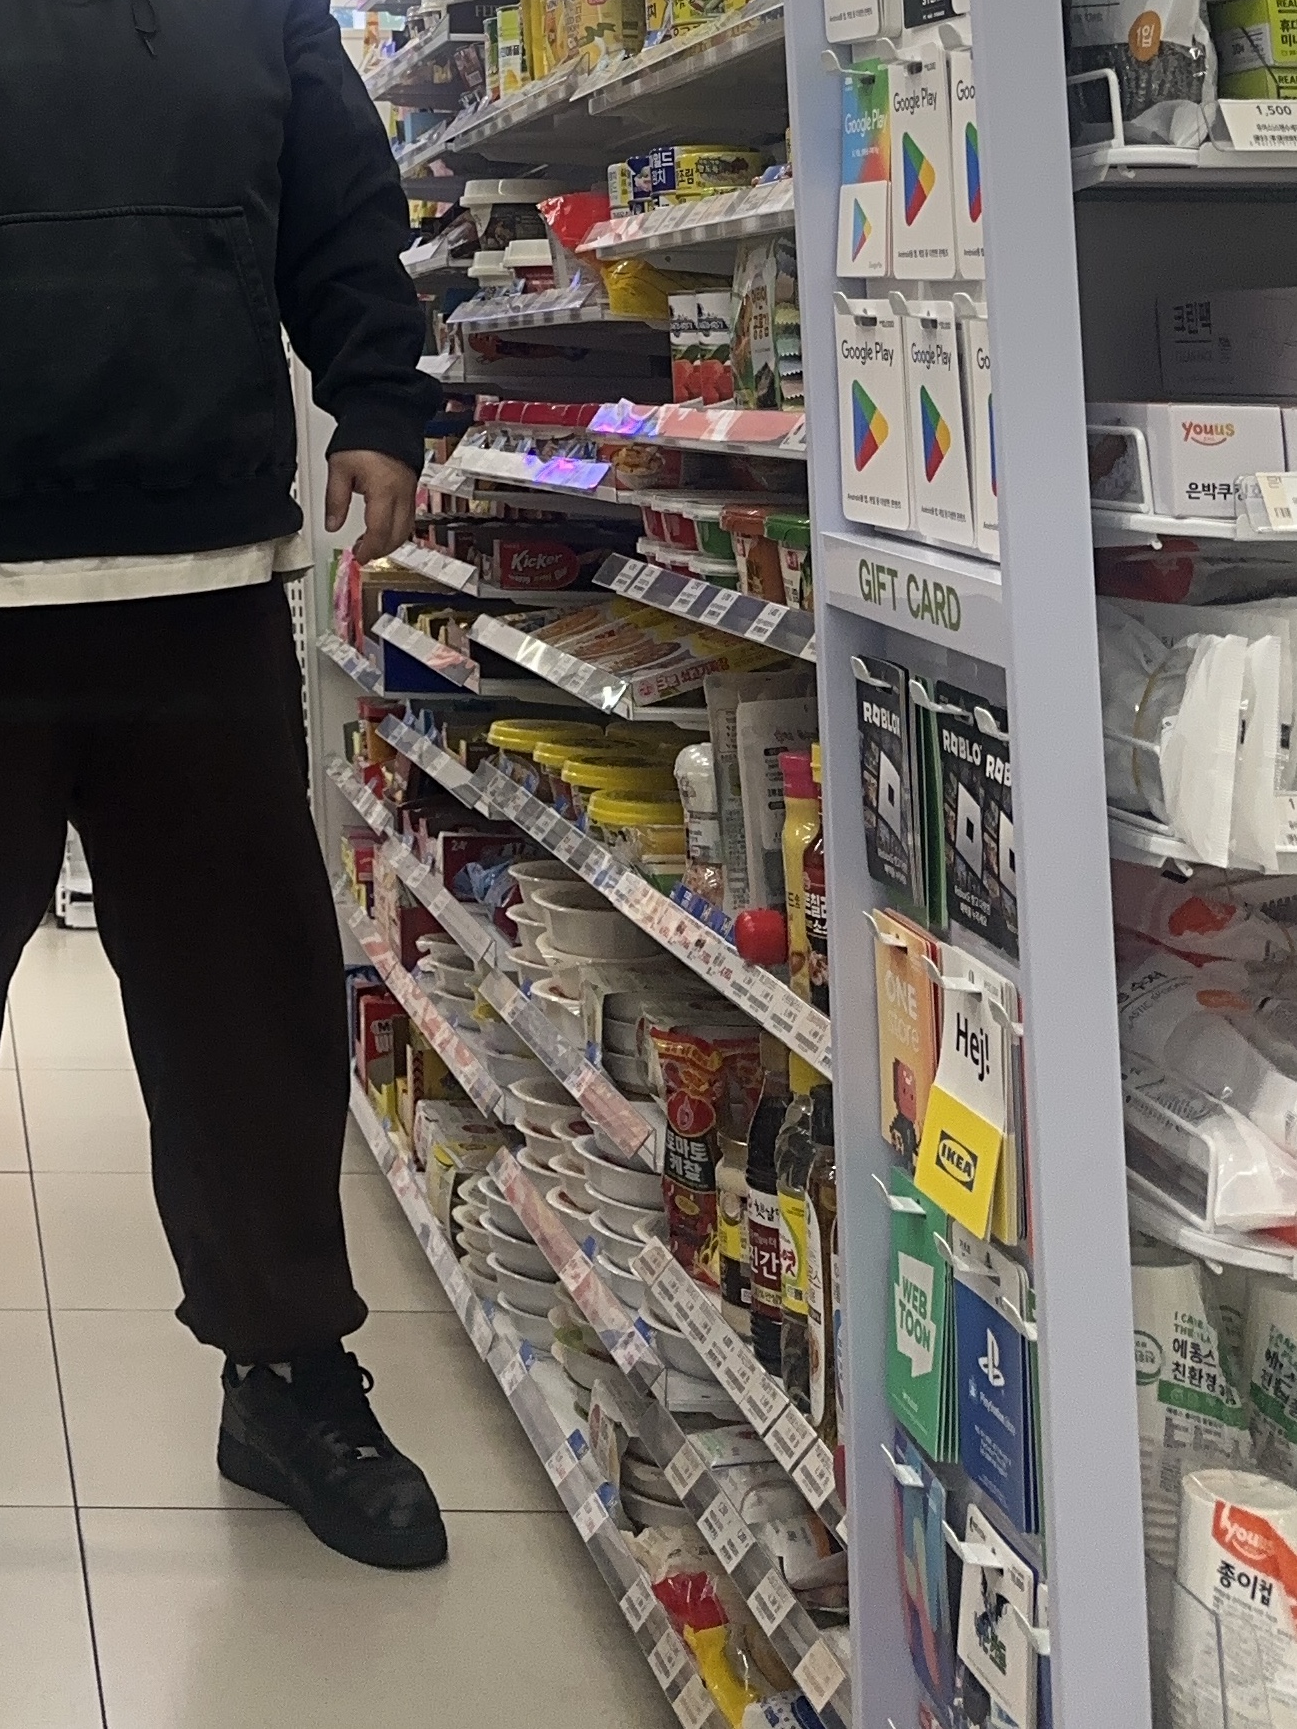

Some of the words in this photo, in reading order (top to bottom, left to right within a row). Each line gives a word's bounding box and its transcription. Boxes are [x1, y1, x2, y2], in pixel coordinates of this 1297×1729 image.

[1136, 22, 1156, 48] 1입
[893, 90, 920, 115] Google
[921, 87, 937, 111] Play
[1255, 105, 1292, 117] 1,500
[844, 111, 871, 138] Google
[872, 108, 889, 133] Play
[841, 339, 873, 366] Google
[875, 341, 894, 367] Play
[911, 342, 935, 369] Google
[936, 345, 952, 371] Play
[1182, 420, 1236, 443] youus
[510, 549, 562, 570] Kicker
[859, 557, 899, 612] GIFT
[906, 571, 962, 633] CARD
[862, 700, 901, 738] ROBLO
[942, 728, 982, 767] ROBLO
[986, 754, 1012, 787] ROB
[884, 970, 919, 1021] ONE
[955, 1012, 990, 1082] Hej!
[666, 1131, 708, 1162] 토마토
[941, 1142, 972, 1179] IKEA
[901, 1275, 928, 1322] WEB
[898, 1298, 931, 1353] TOON
[1172, 1360, 1217, 1393] 친환경
[1216, 1559, 1274, 1608] 종이컵
